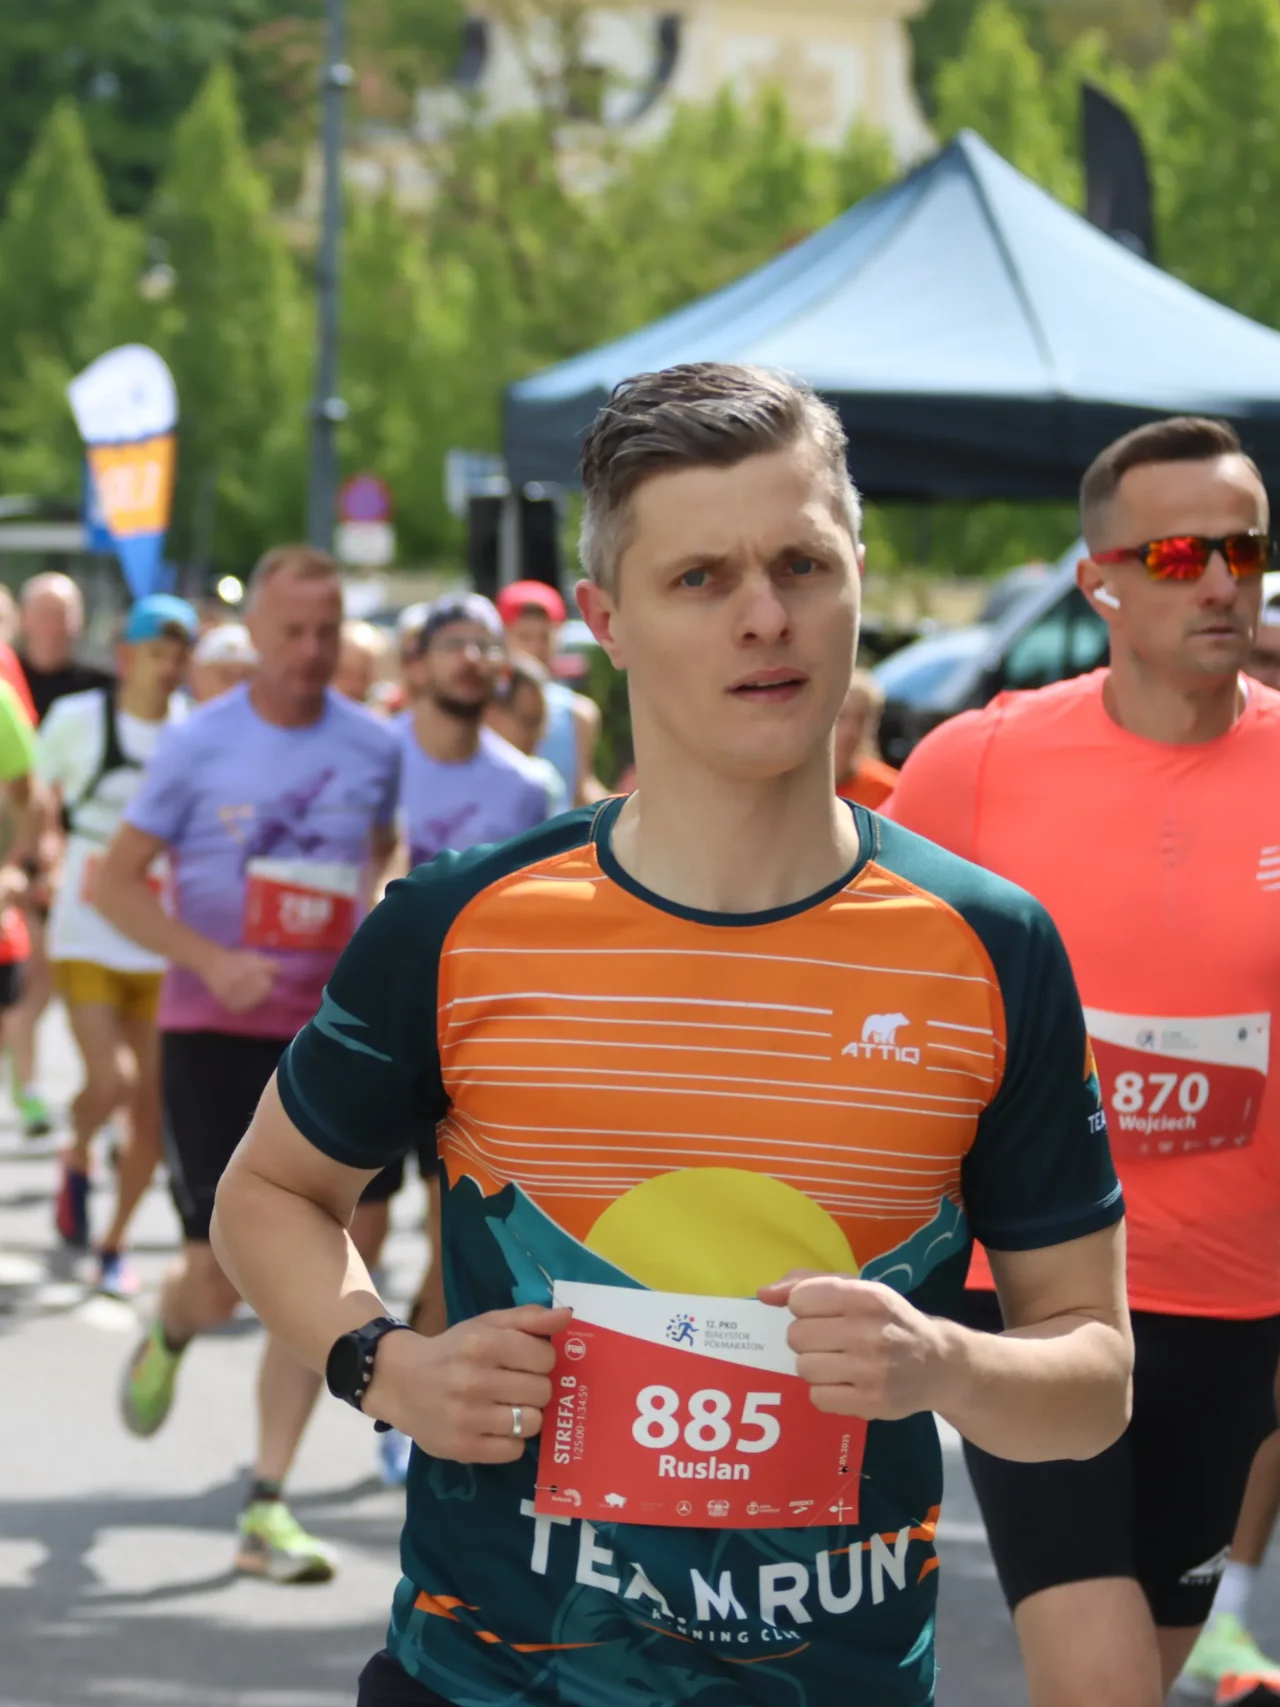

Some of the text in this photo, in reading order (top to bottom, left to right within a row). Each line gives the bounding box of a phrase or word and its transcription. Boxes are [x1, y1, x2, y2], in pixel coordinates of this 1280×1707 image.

[841, 1041, 920, 1066] ATTIQ
[1111, 1072, 1209, 1113] 870
[1119, 1115, 1197, 1135] Wojciech
[554, 1376, 577, 1464] STREFA B
[631, 1385, 782, 1453] 885
[658, 1454, 750, 1480] Ruslan
